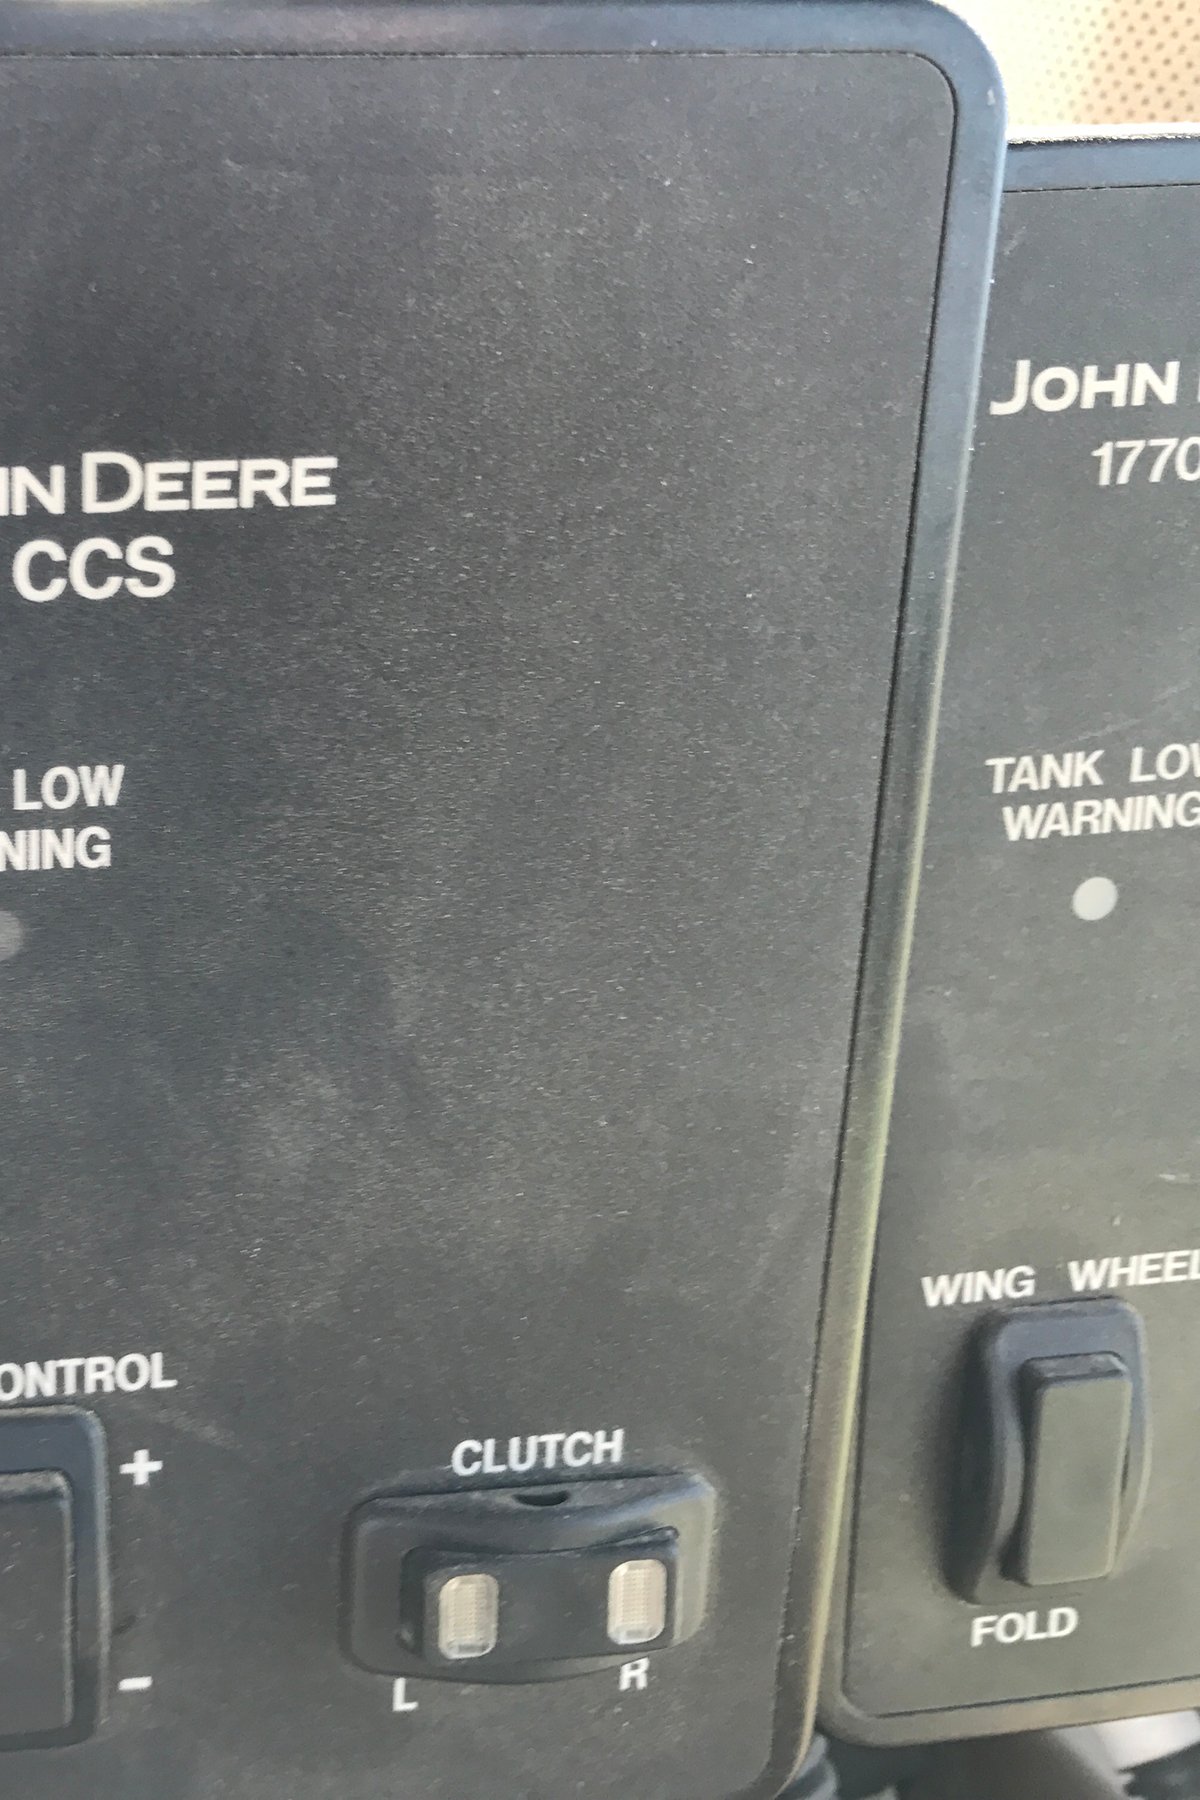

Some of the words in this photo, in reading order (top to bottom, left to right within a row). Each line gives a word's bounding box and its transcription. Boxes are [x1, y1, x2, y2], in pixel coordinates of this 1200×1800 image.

[990, 360, 1180, 415] JOHN
[81, 452, 338, 514] DEERE
[1091, 436, 1200, 486] 1770
[12, 535, 176, 602] CCS
[13, 765, 125, 811] LOW
[985, 749, 1105, 794] TANK
[1002, 790, 1200, 841] WARNING
[921, 1265, 1036, 1307] WING
[453, 1429, 626, 1475] CLUTCH
[970, 1607, 1078, 1647] FOLD
[393, 1677, 419, 1712] L
[618, 1657, 650, 1691] R
